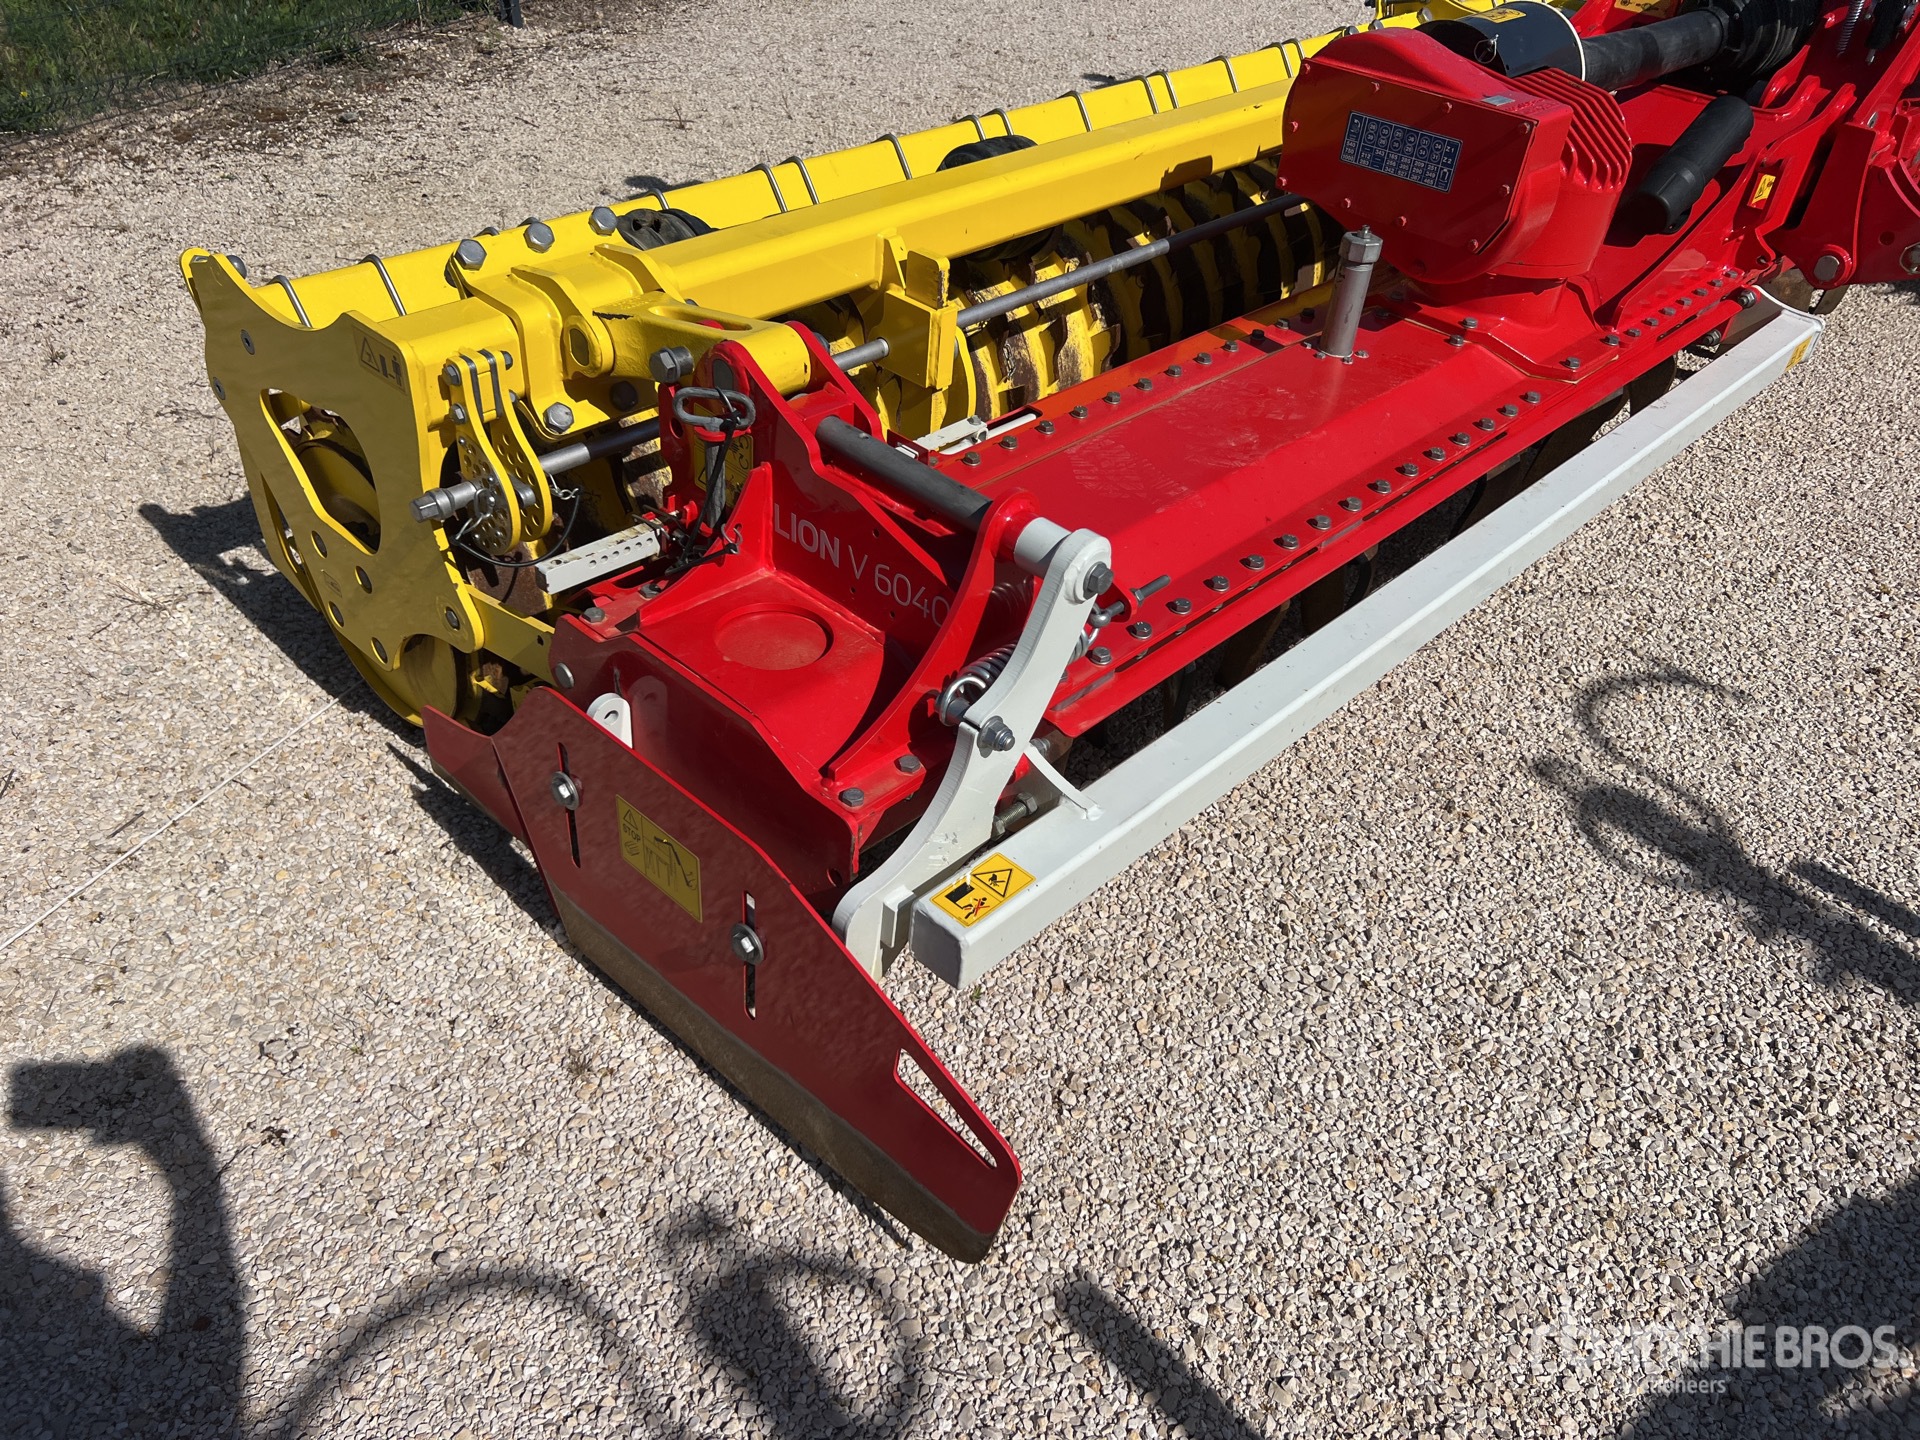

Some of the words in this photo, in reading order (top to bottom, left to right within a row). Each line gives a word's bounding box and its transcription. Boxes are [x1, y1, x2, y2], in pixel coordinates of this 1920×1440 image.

[774, 502, 840, 569] LION
[848, 544, 868, 580] V
[874, 563, 951, 628] 6040
[622, 823, 641, 842] STOP
